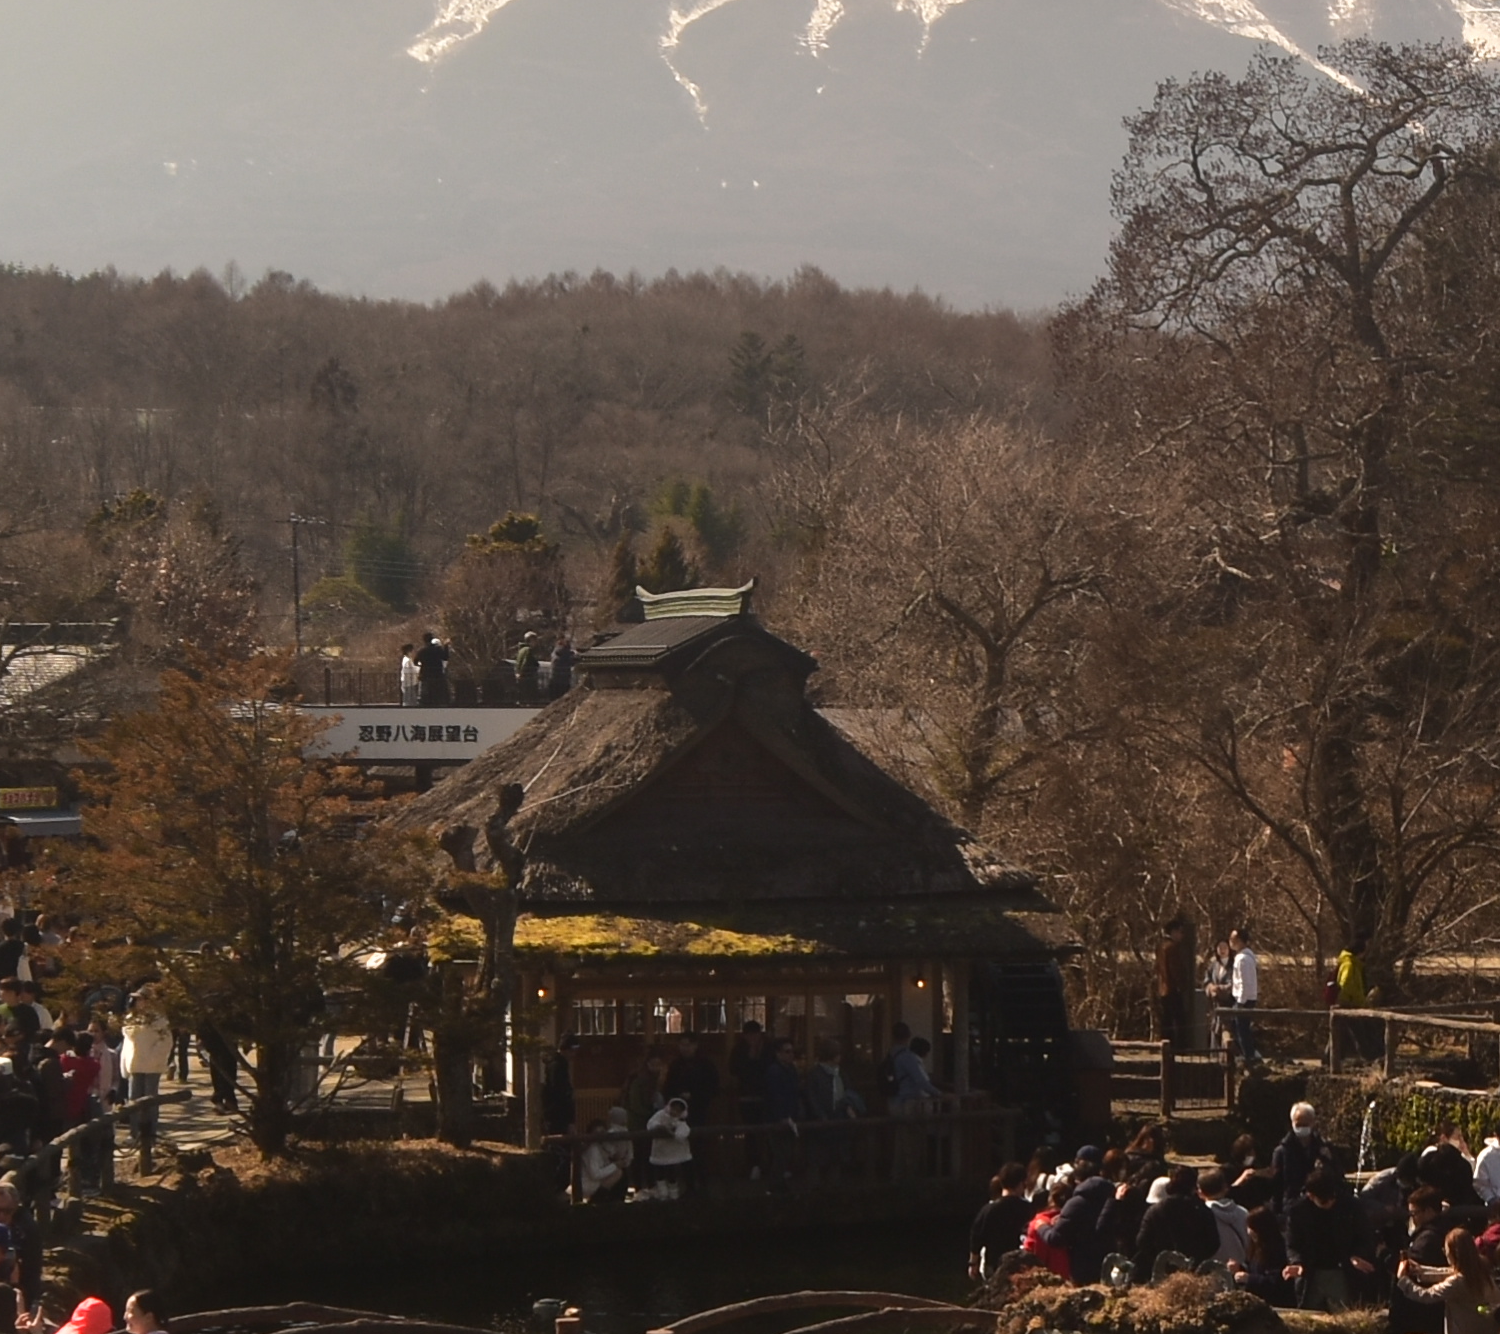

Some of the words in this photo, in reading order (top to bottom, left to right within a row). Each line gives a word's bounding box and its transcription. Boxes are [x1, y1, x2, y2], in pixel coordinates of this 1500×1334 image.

[358, 725, 479, 743] 忍野八海展望台
